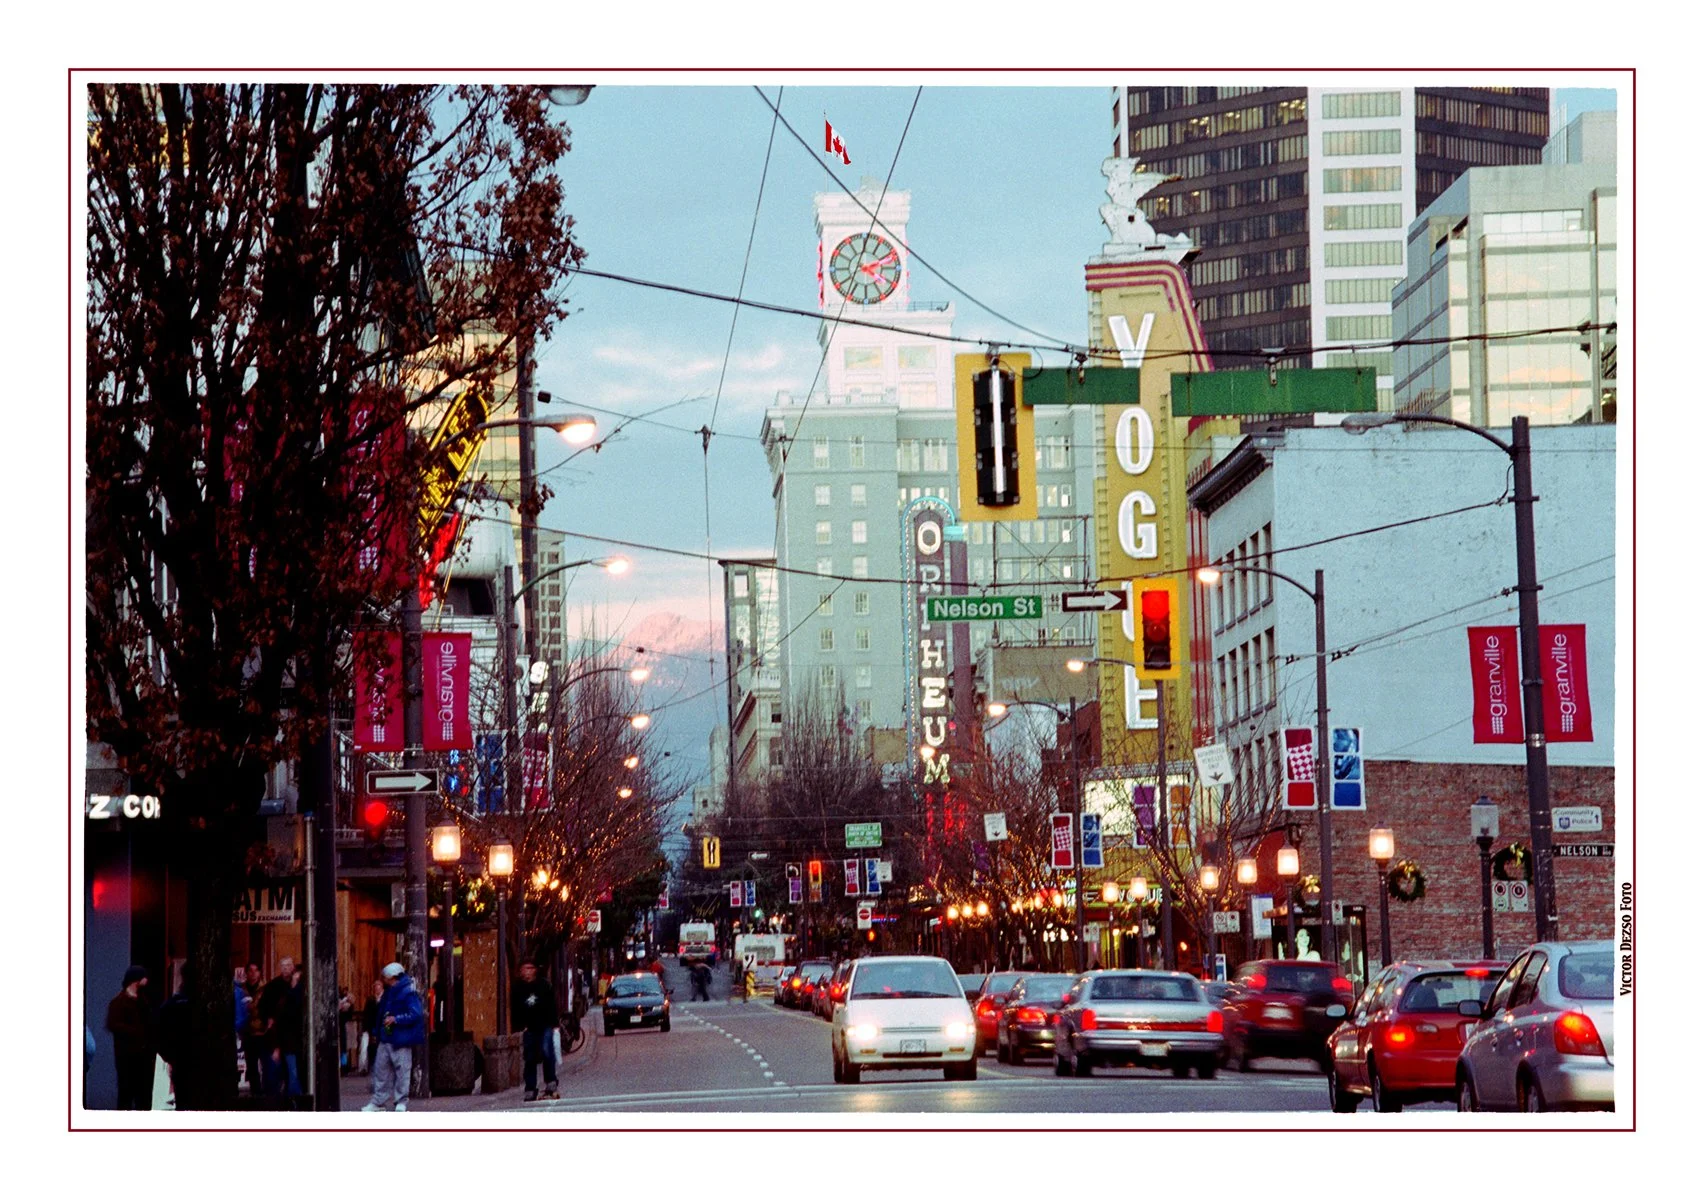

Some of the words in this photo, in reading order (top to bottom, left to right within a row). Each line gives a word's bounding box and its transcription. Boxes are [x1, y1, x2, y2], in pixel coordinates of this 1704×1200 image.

[934, 600, 1004, 618] Nelson
[1013, 597, 1036, 616] St
[1484, 635, 1508, 716] granville
[1551, 633, 1577, 715] granville
[1560, 845, 1598, 856] NELSON
[231, 887, 293, 911] ATM
